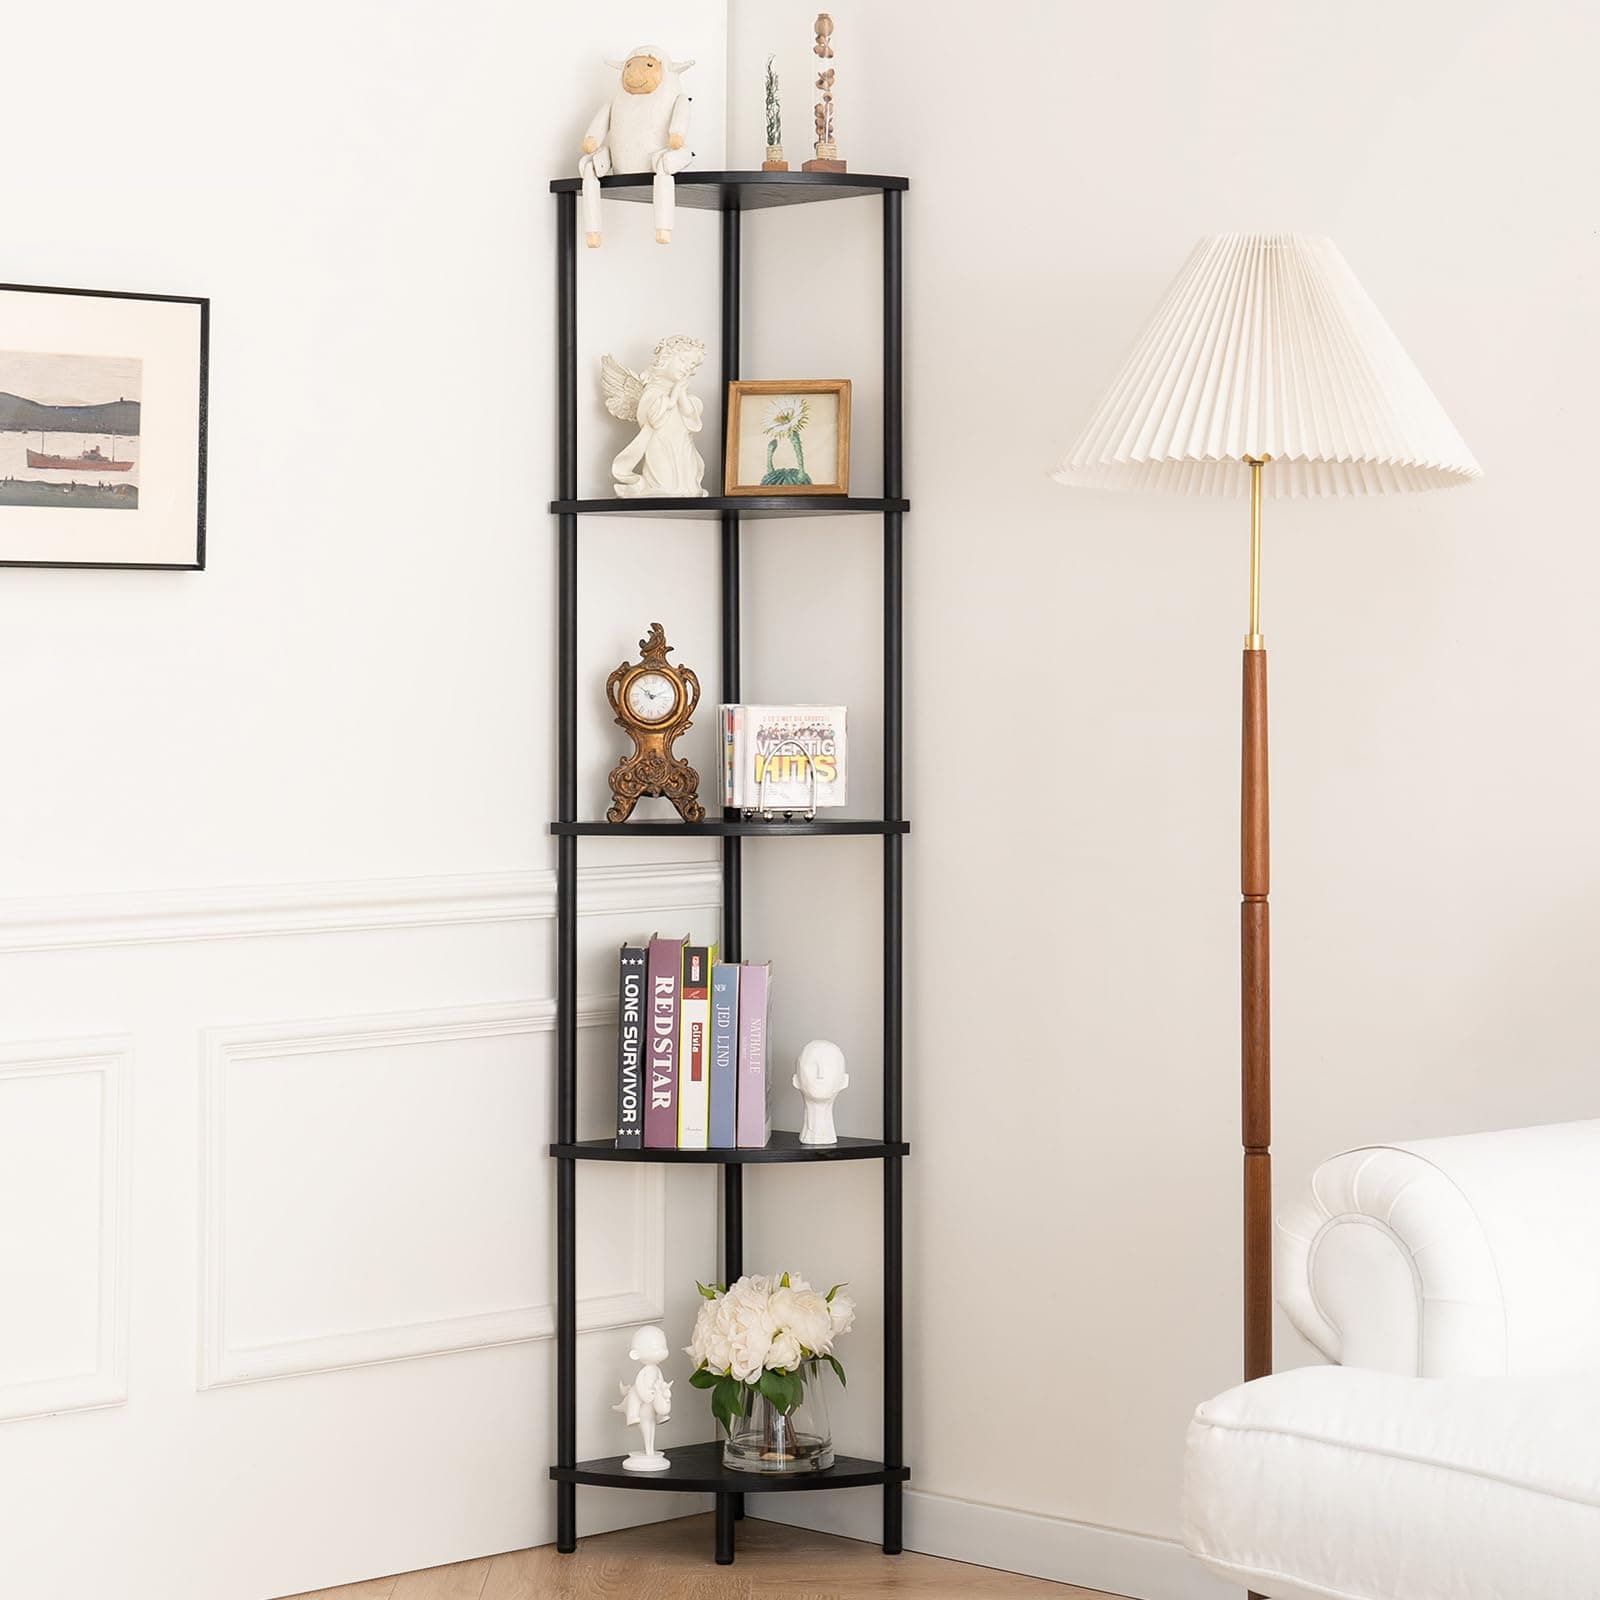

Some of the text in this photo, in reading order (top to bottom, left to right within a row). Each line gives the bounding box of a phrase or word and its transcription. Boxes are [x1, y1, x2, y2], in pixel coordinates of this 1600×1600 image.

[755, 754, 837, 784] HITS
[622, 975, 639, 1123] LONE SURVIVOR
[651, 975, 675, 1110] REDSTAR
[692, 1023, 702, 1053] olivia
[716, 1003, 730, 1068] JED LIND
